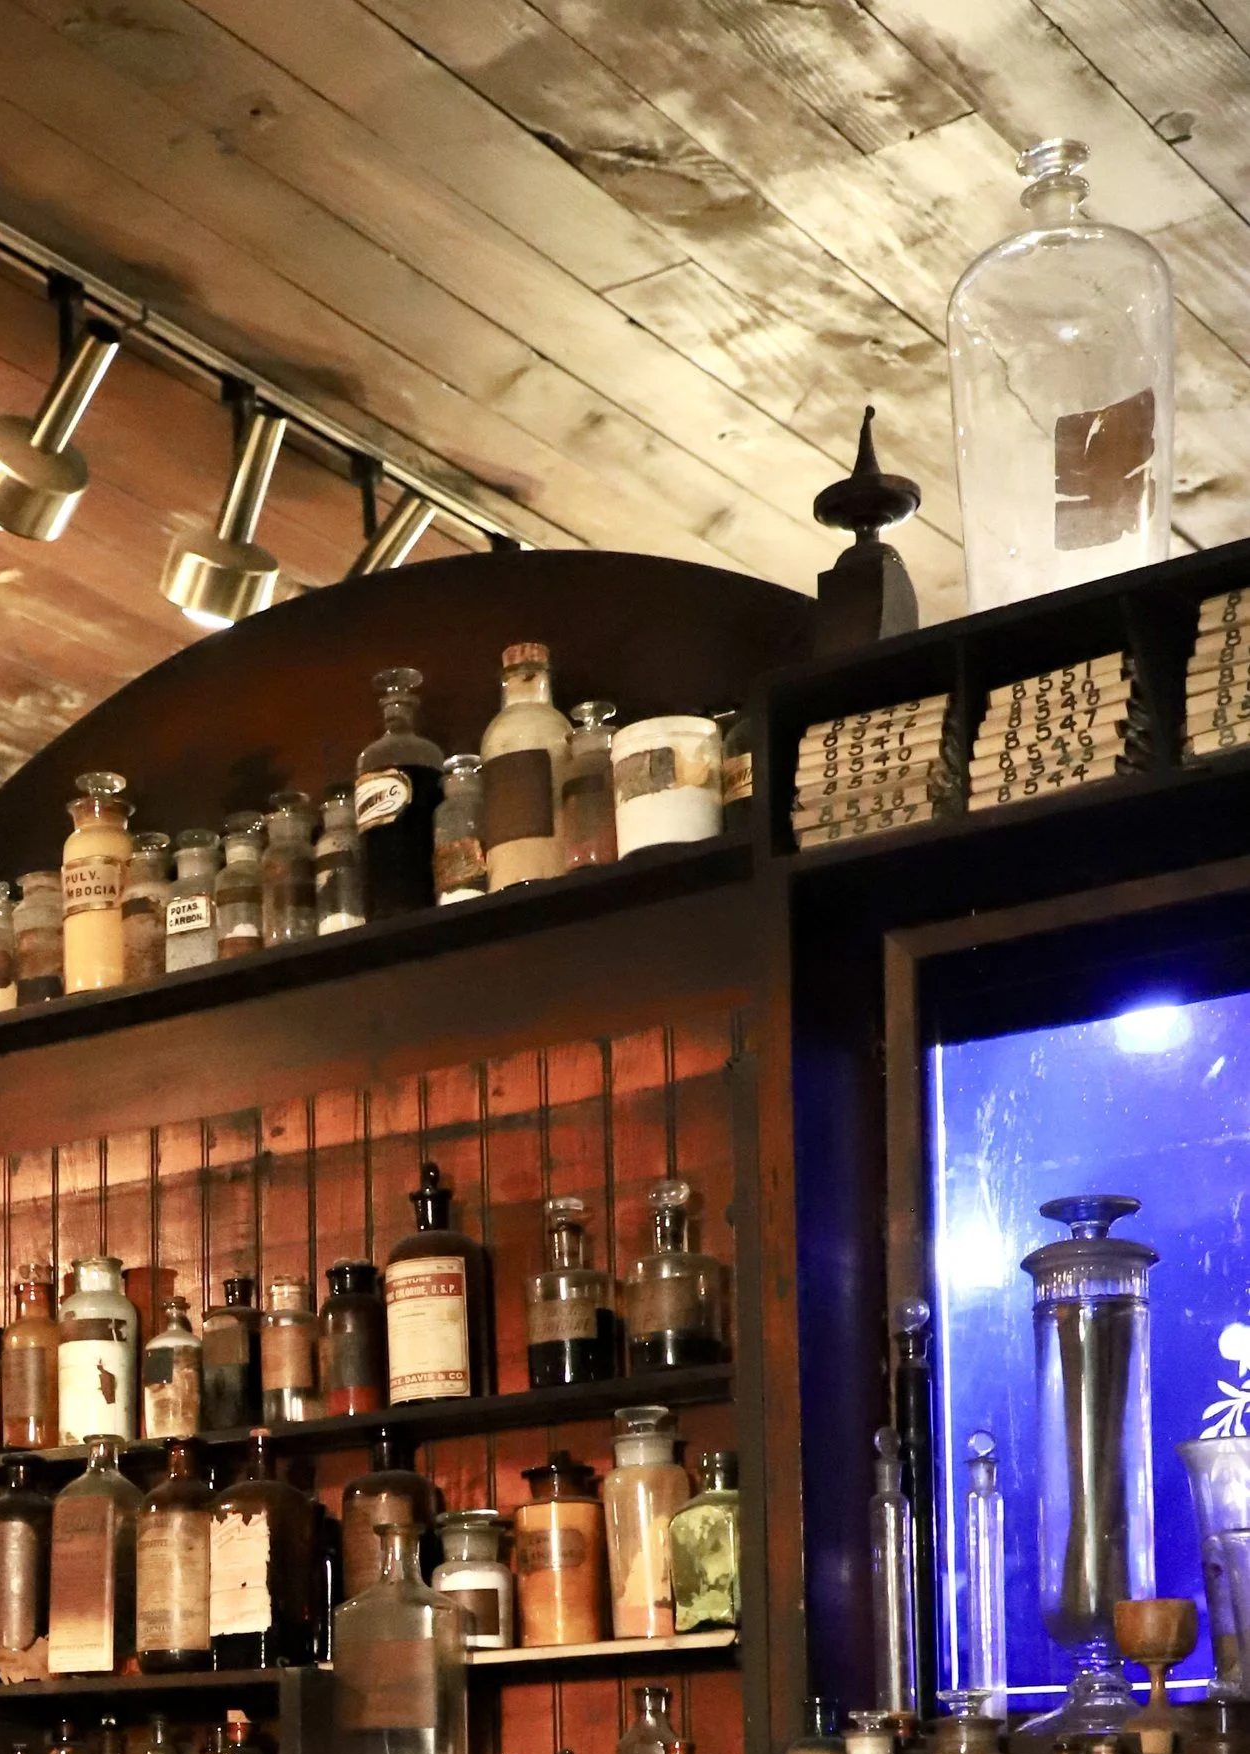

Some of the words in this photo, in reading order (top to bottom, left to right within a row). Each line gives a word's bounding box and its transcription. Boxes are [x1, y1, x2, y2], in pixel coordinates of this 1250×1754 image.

[1012, 662, 1092, 700] 8551
[825, 731, 905, 762] 8541
[1004, 709, 1097, 750] 8547
[823, 747, 912, 779] 8540
[999, 730, 1093, 770] 8546
[1003, 747, 1094, 783] 8545
[997, 764, 1089, 803] 8544
[818, 788, 905, 824] 8538
[827, 805, 918, 840] 8537
[65, 870, 101, 885] PULV.
[168, 914, 205, 928] CARBON.
[170, 902, 200, 916] POTAS.
[404, 1373, 435, 1384] DAVIS
